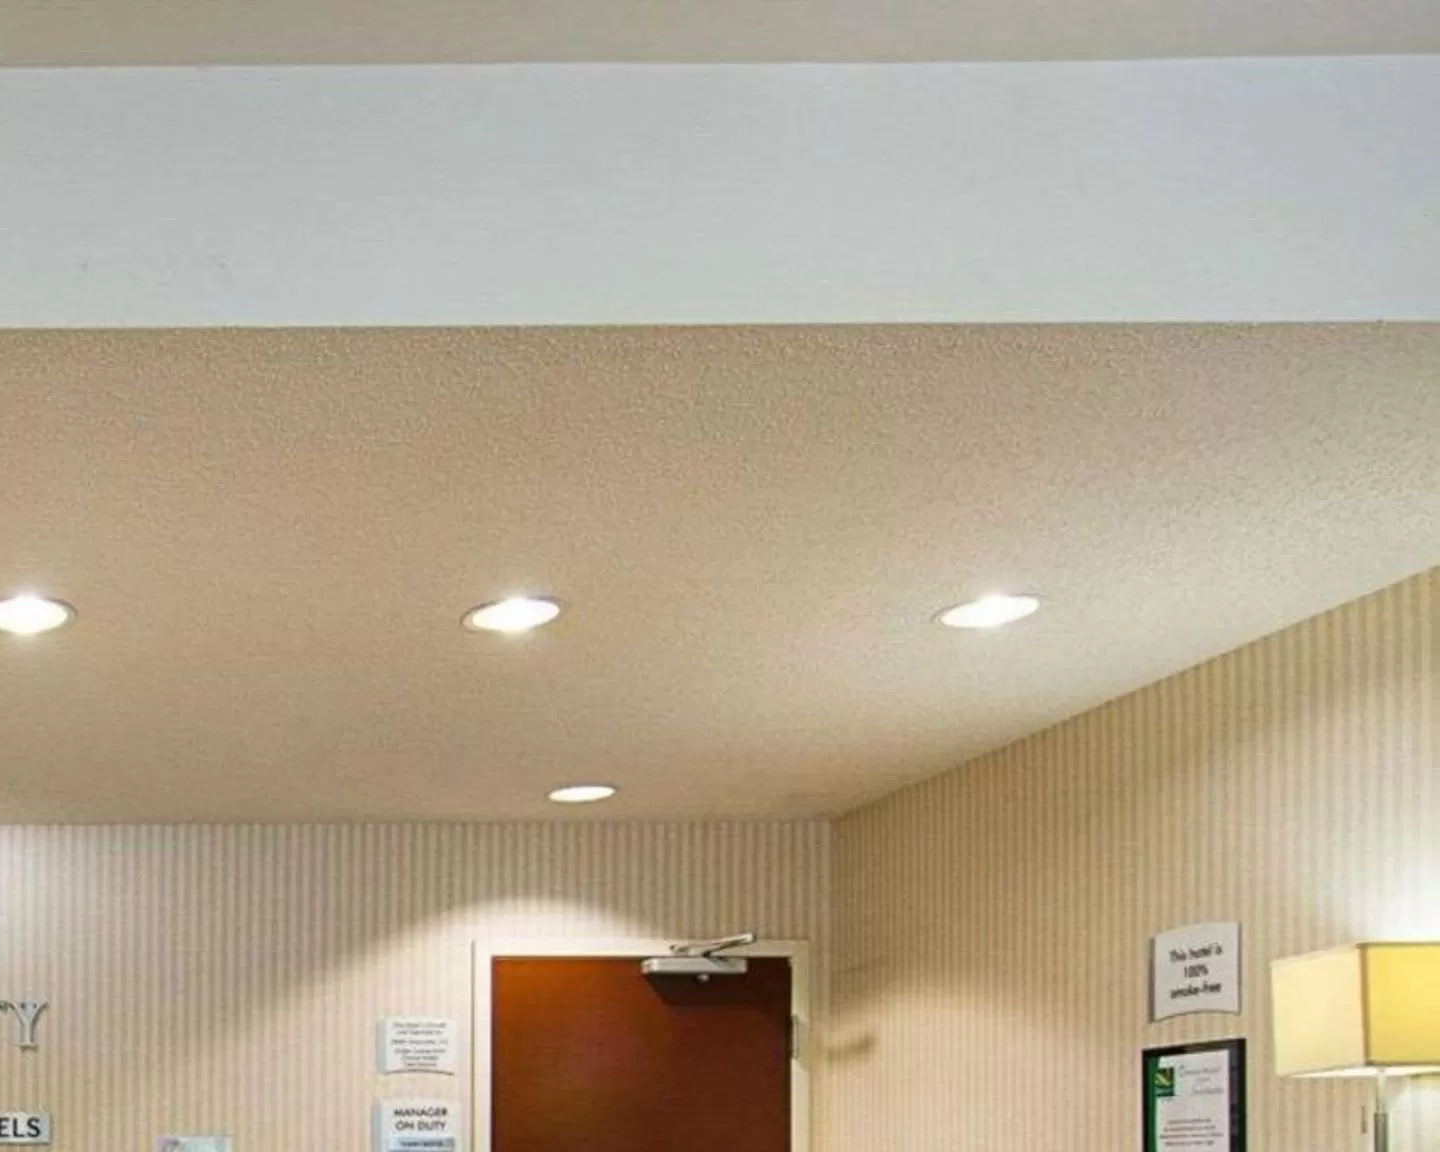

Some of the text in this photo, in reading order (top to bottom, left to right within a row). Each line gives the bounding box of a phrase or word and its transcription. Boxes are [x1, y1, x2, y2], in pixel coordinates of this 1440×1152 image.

[393, 1106, 448, 1118] MANAGER
[395, 1120, 446, 1131] ON DUTY
